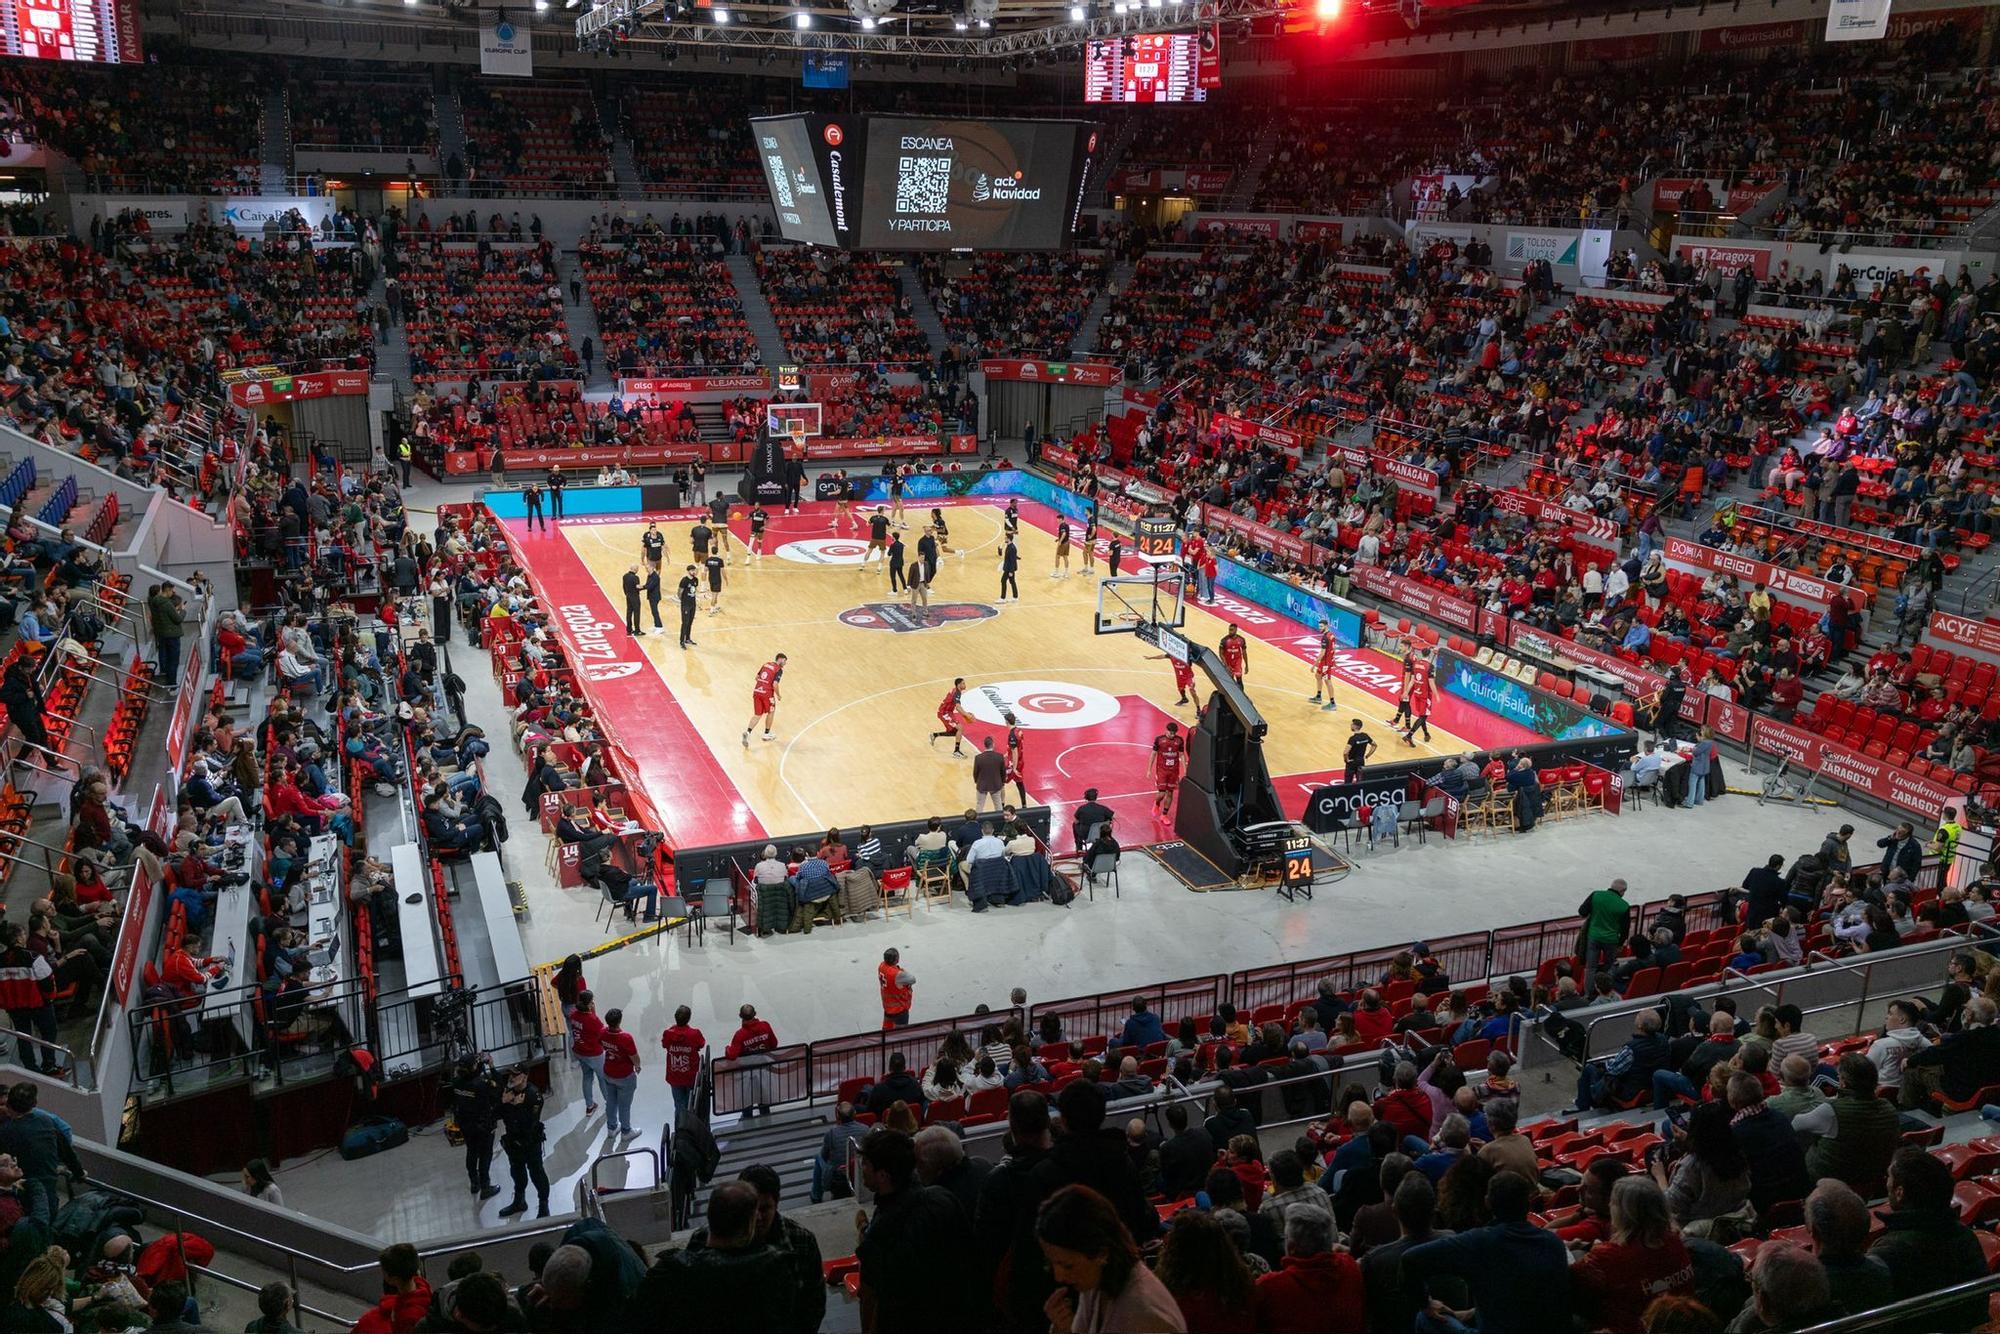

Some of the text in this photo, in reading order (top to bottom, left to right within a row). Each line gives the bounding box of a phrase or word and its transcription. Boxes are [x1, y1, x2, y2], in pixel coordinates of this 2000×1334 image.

[120, 3, 137, 59] AMBAR
[901, 137, 953, 150] ESCANEA
[994, 177, 1017, 186] acb
[830, 150, 849, 232] Casademont
[992, 187, 1041, 200] Navidad
[888, 219, 952, 232] Y PARTICIPA
[1527, 237, 1557, 247] TOLDOS
[1526, 249, 1556, 261] LUCAS
[1709, 248, 1756, 264] Zaragoza
[633, 382, 654, 390] alsa
[705, 378, 764, 387] ALEJANDRO
[784, 375, 798, 385] 24
[1152, 523, 1176, 533] 11:27
[1140, 536, 1150, 554] 24
[1152, 538, 1174, 555] 24
[1400, 581, 1434, 602] Casademont
[1788, 579, 1822, 596] LACOR
[1401, 594, 1430, 612] ZARAGOZA
[1437, 595, 1473, 617] Casademont
[1439, 608, 1469, 626] ZARAGOZA
[559, 603, 618, 661] Zaragoza
[1934, 617, 1978, 638] ACYF
[1953, 634, 1975, 644] GROUP
[1554, 640, 1597, 664] Casademont
[505, 674, 517, 684] 11
[1601, 659, 1647, 684] Casademont
[1754, 719, 1813, 750] Casademont
[1819, 742, 1881, 776] Casademont
[1610, 774, 1621, 787] 16
[1822, 761, 1873, 790] ZARAGOZA
[543, 793, 560, 808] 14
[1318, 787, 1407, 815] endesa
[1446, 798, 1458, 812] 16
[1286, 837, 1309, 850] 11:27
[562, 845, 579, 859] 14
[1287, 857, 1312, 880] 24
[670, 1054, 690, 1067] IMS
